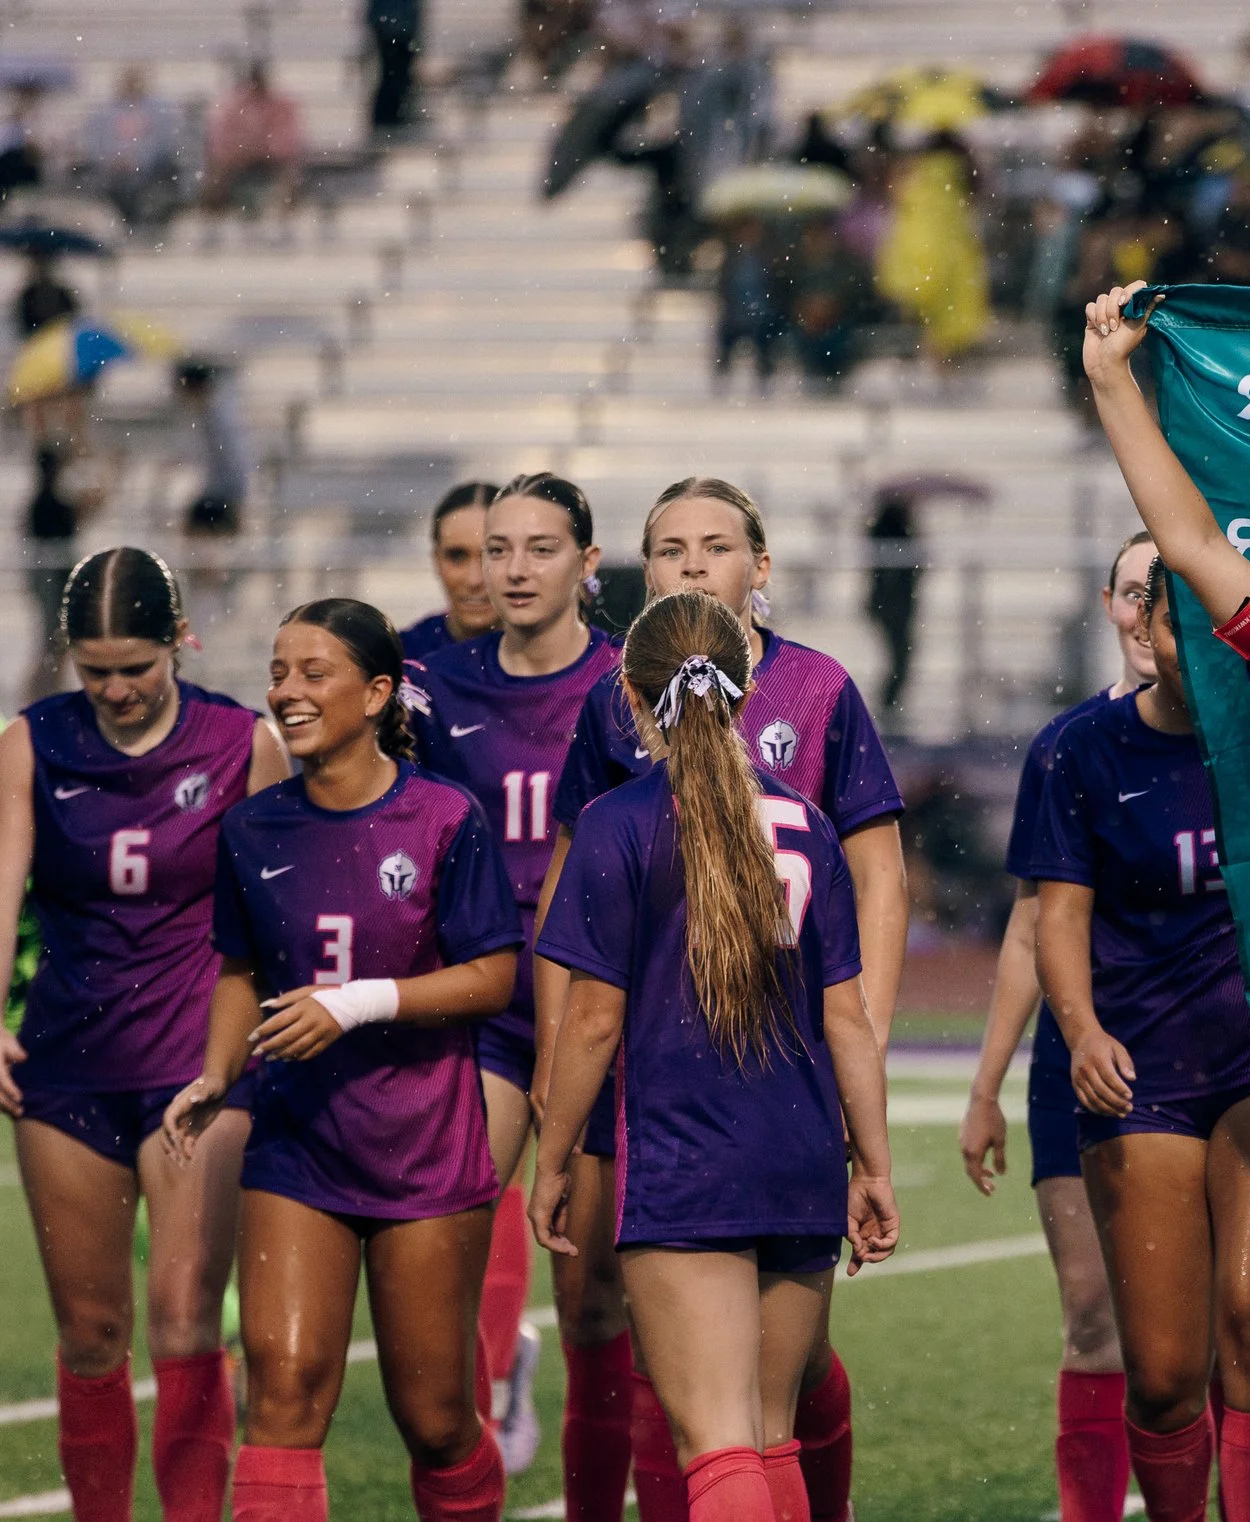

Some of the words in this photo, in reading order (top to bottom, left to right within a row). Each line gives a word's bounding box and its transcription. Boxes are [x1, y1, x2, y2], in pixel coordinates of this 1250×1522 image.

[503, 770, 550, 842] 11
[109, 828, 151, 896] 6
[313, 913, 355, 987] 3
